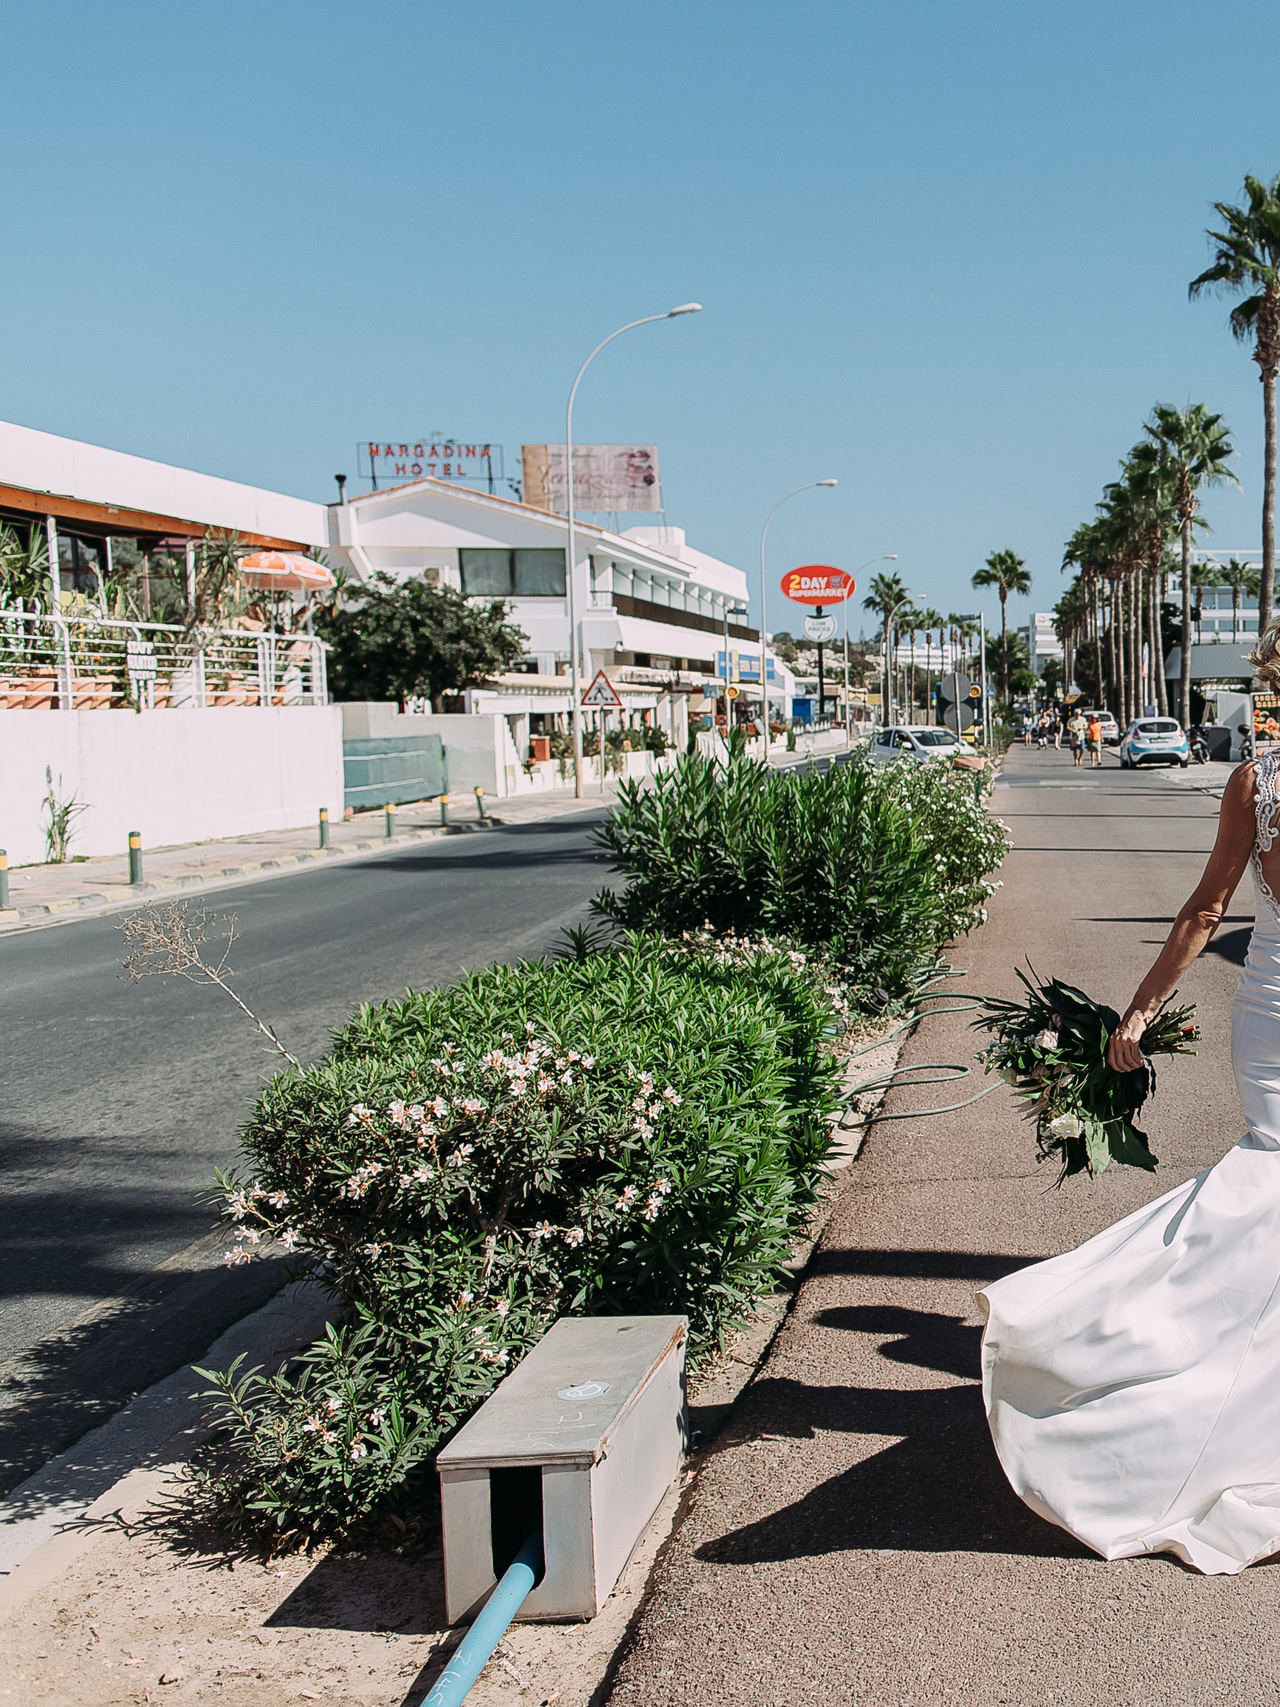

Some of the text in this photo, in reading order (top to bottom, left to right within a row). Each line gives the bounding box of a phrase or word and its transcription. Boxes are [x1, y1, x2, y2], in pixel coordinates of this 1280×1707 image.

[368, 442, 491, 458] MARGADINA
[395, 463, 467, 476] HOTEL
[789, 574, 829, 589] 2DAY
